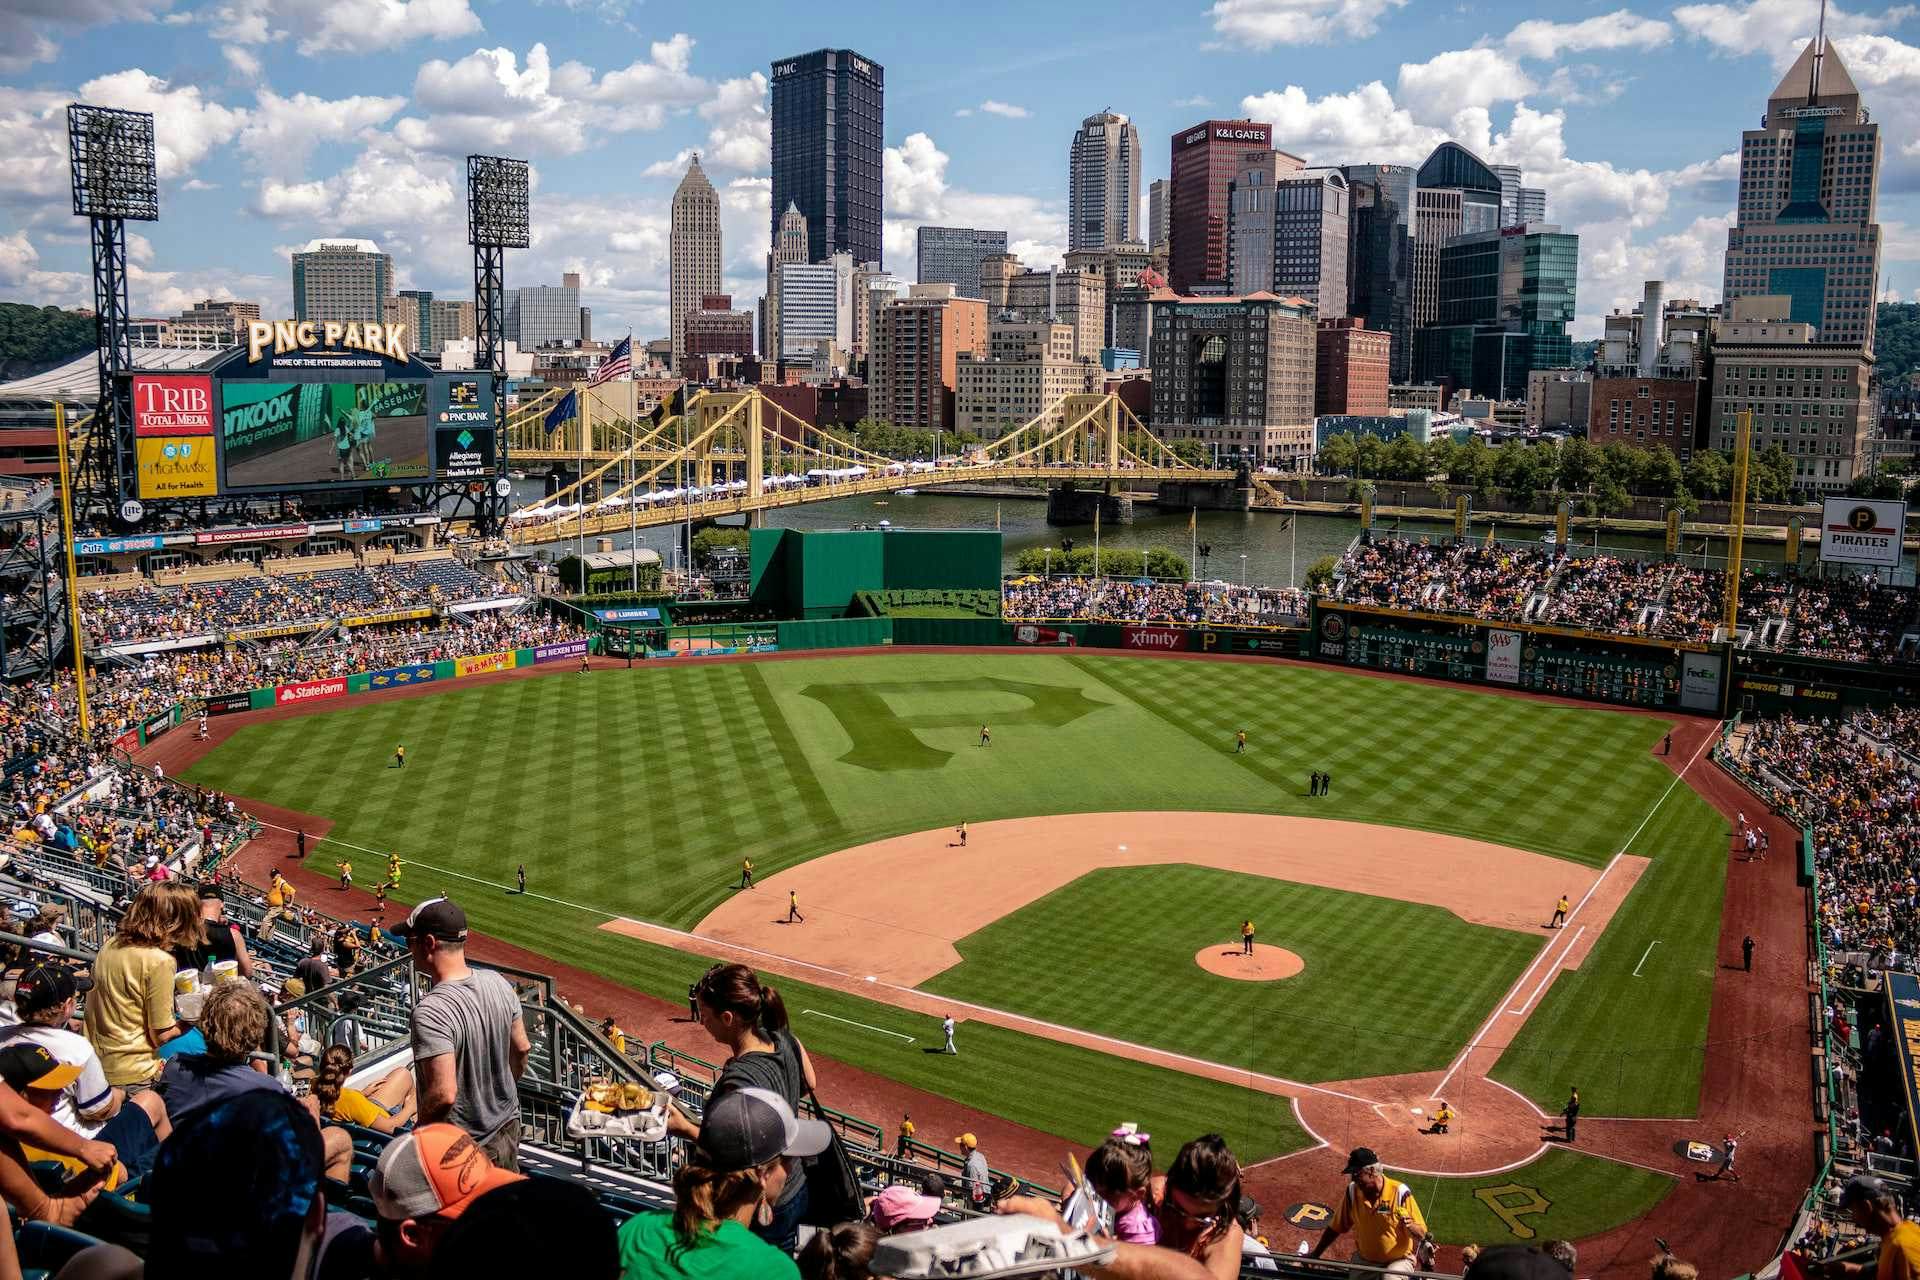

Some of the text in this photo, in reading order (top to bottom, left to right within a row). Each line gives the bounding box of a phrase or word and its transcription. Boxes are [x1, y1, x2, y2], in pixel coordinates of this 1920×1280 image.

[853, 57, 872, 76] UPMC
[1216, 129, 1266, 140] K&L GATES
[247, 319, 409, 364] PNC PARK
[272, 358, 383, 367] HOME OF THE PITTSBURGH PIRATES
[138, 382, 208, 413] TRIB
[141, 413, 209, 425] TOTAL MEDIA
[449, 412, 488, 421] PNC BANK
[449, 452, 482, 461] Allegheny
[446, 467, 485, 477] Health for All
[156, 481, 204, 490] All for Health
[1856, 511, 1869, 527] P
[1832, 534, 1889, 548] PIRATES
[1831, 545, 1889, 556] CHARITIES
[618, 610, 649, 618] LUMBER
[245, 624, 317, 639] IRON CITY BEER
[1131, 630, 1179, 648] xfinity
[1362, 633, 1469, 653] NATIONAL LEAGUE
[548, 646, 570, 657] NEXEN
[571, 643, 586, 652] TIRE
[480, 652, 509, 669] MASON
[1538, 655, 1661, 678] AMERICAN LEAGUE
[1686, 668, 1716, 680] FedEx
[296, 683, 343, 699] State Farm
[1803, 688, 1838, 700] BLASTS
